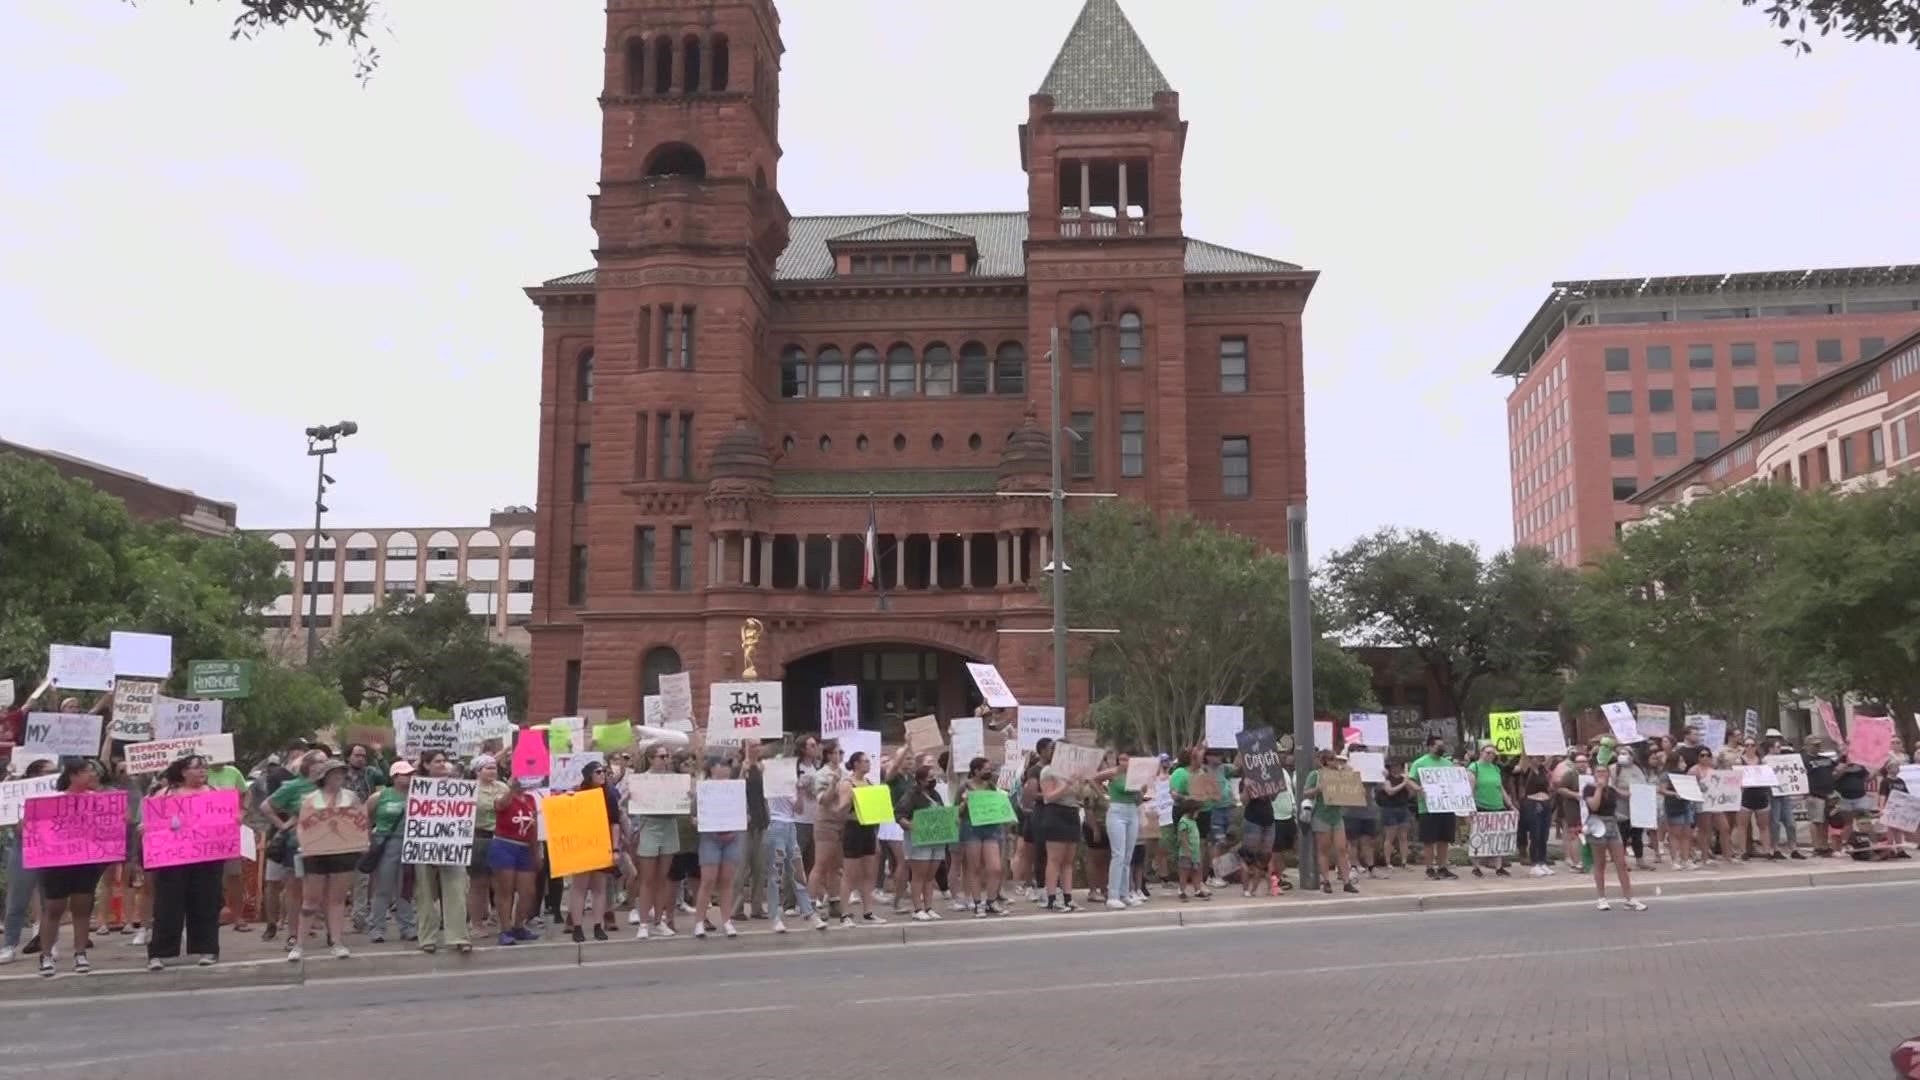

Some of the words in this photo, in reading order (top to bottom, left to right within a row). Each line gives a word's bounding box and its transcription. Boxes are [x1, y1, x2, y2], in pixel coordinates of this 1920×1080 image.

[730, 703, 762, 715] WITH
[734, 716, 760, 728] HER
[27, 724, 51, 743] MY
[411, 780, 432, 794] MY
[436, 781, 477, 797] BODY
[407, 820, 456, 838] BELONG
[404, 841, 473, 864] GOVERNMENT
